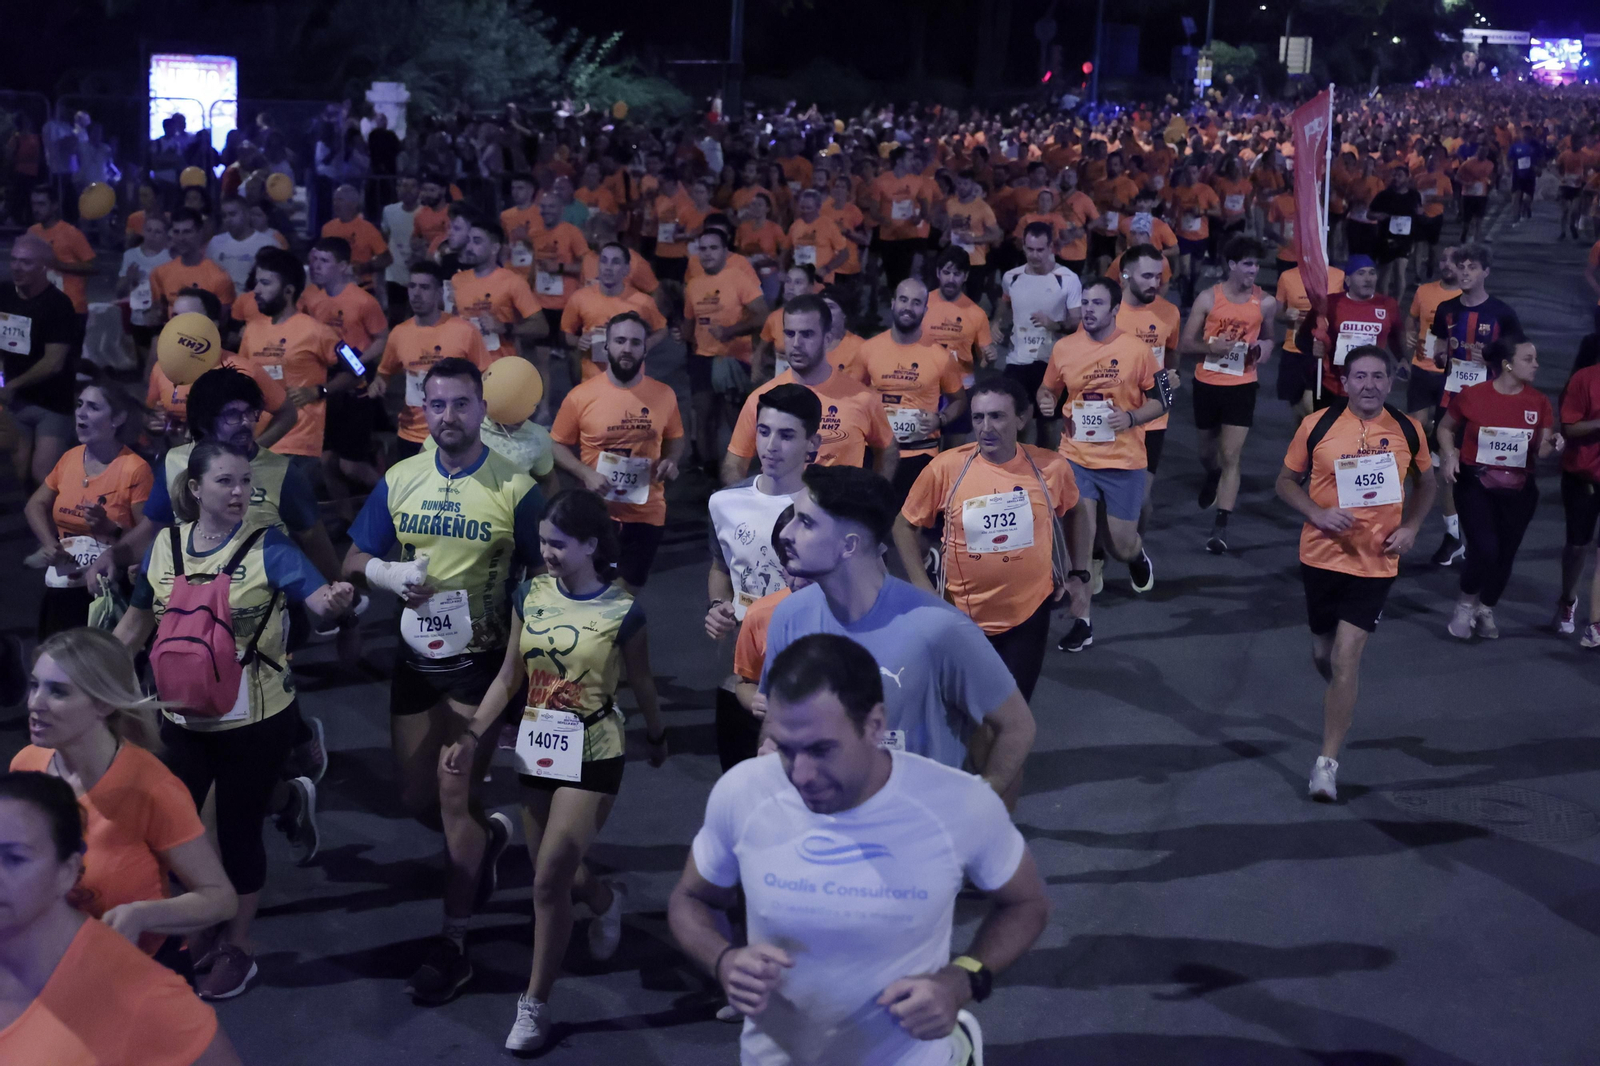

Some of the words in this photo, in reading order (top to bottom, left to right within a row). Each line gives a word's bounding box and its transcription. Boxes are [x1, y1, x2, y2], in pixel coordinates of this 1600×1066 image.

[1342, 323, 1380, 333] BILIO'S
[1024, 336, 1045, 346] 15672
[1455, 370, 1479, 381] 15657
[821, 423, 841, 431] KH7
[893, 421, 916, 432] 3420
[1081, 414, 1103, 426] 3525
[1489, 440, 1519, 453] 18244
[611, 470, 638, 485] 3733
[1354, 471, 1385, 487] 4526
[421, 499, 462, 513] RUNNERS
[983, 511, 1017, 529] 3732
[398, 512, 493, 543] BARREÑOS
[416, 614, 452, 632] 7294
[528, 730, 569, 752] 14075
[763, 873, 816, 893] Qualis
